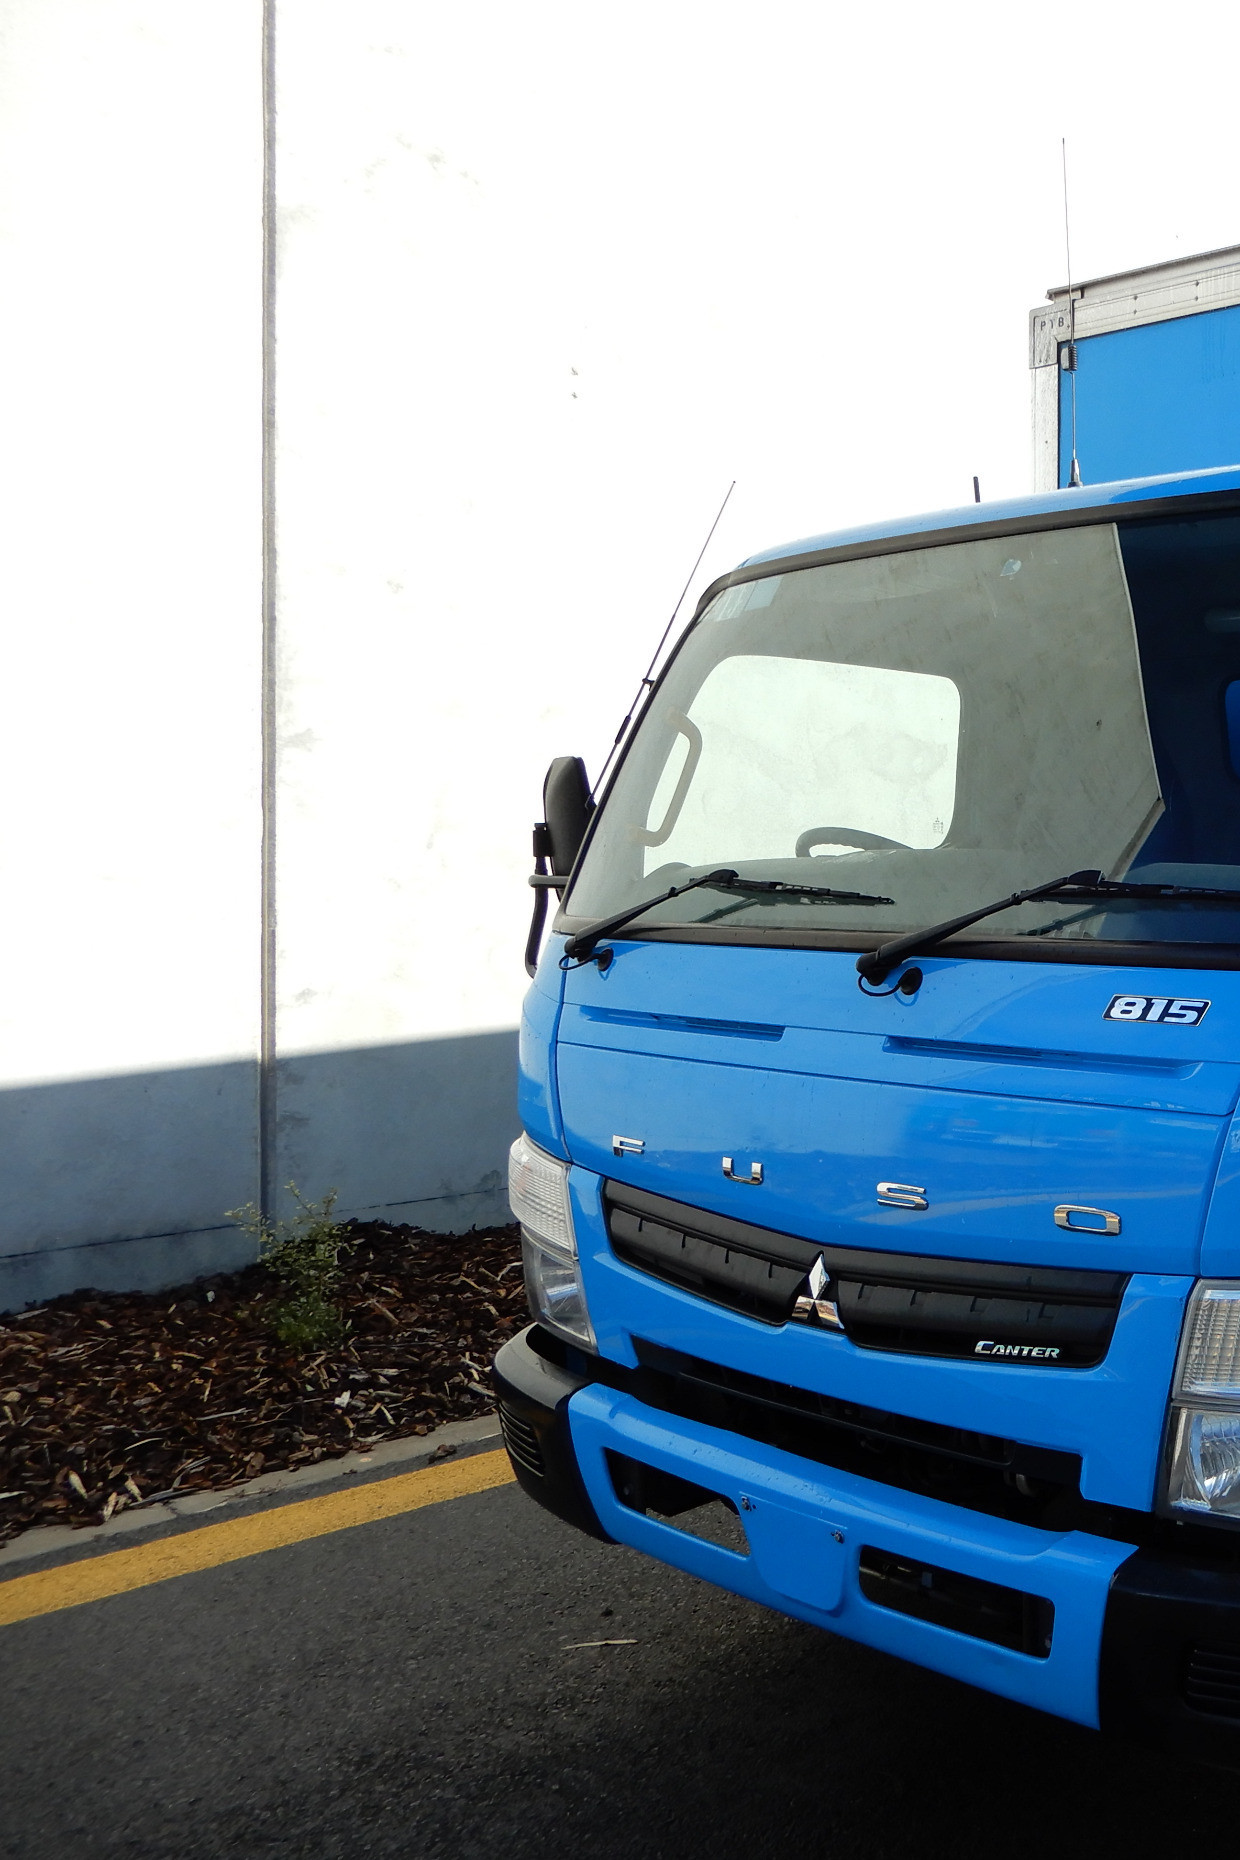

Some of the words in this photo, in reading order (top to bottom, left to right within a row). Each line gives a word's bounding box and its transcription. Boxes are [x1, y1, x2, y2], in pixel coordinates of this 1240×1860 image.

[1110, 996, 1205, 1024] 815
[612, 1133, 1122, 1236] FUSO
[974, 1340, 1060, 1359] CANTER
